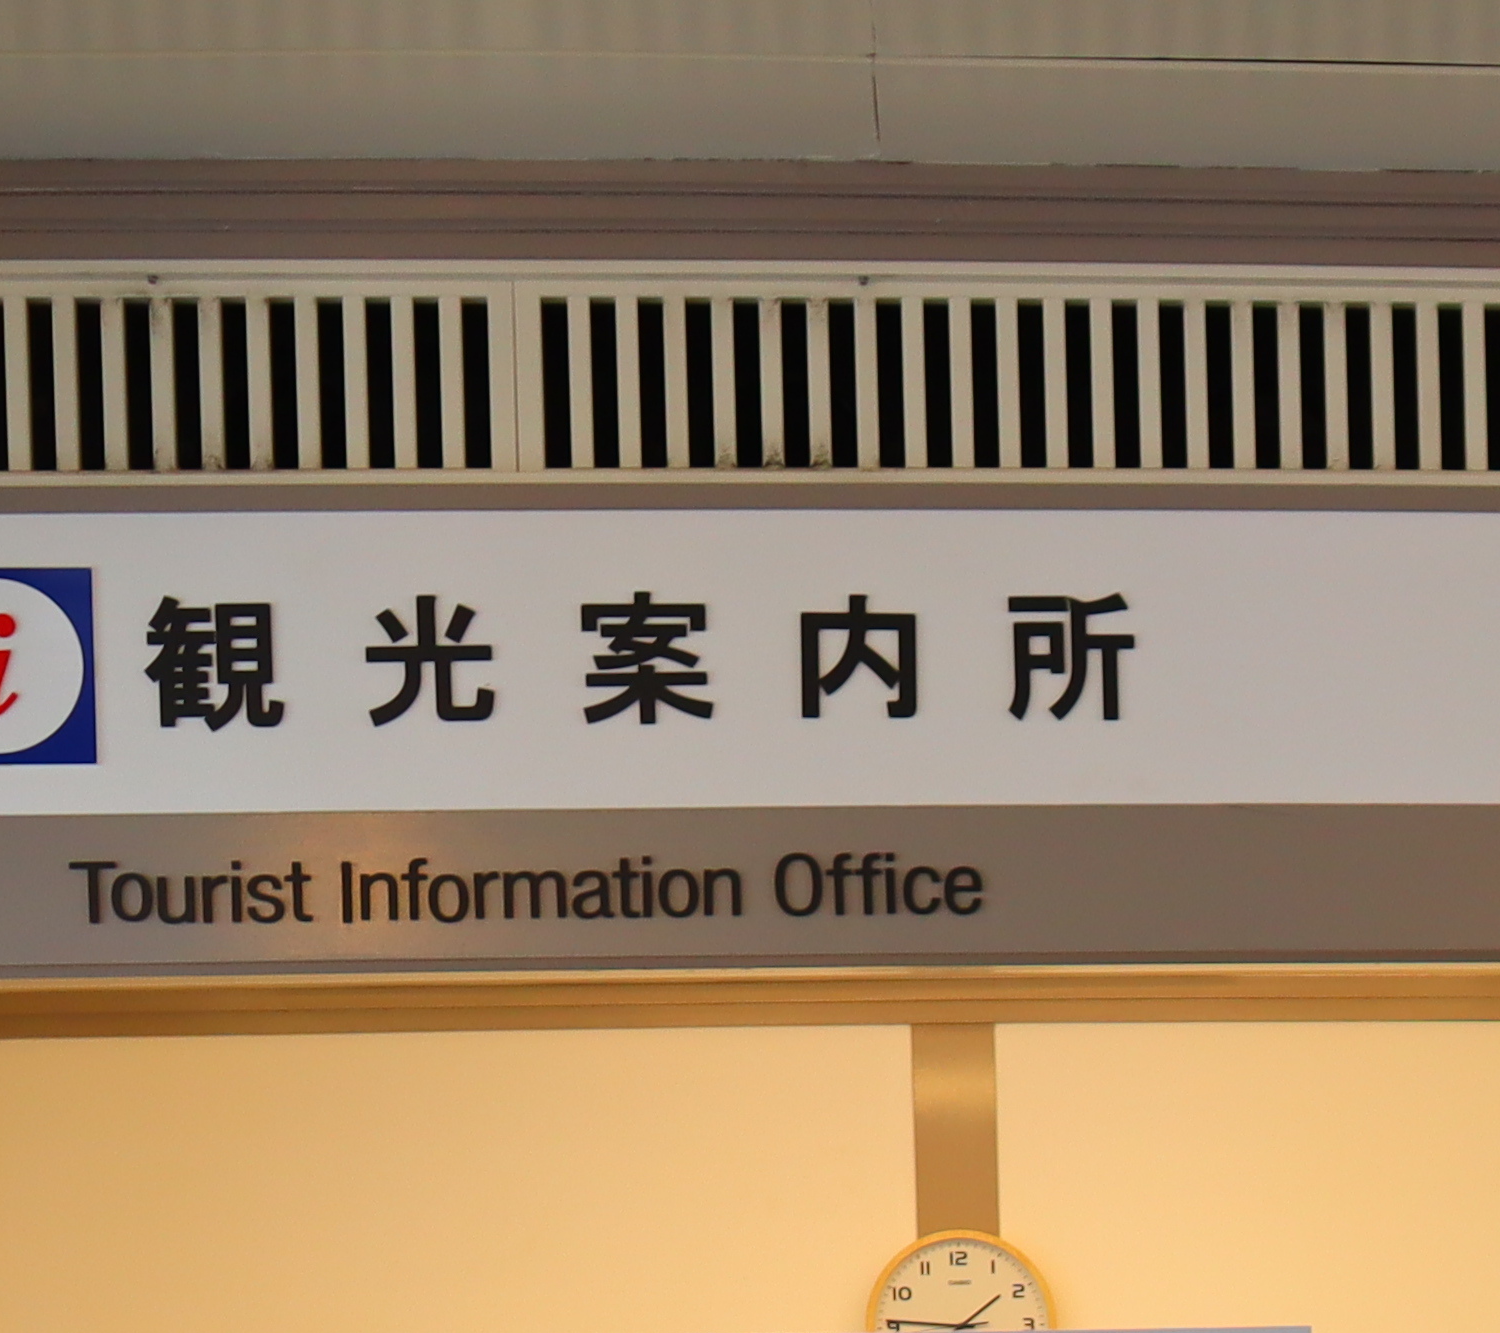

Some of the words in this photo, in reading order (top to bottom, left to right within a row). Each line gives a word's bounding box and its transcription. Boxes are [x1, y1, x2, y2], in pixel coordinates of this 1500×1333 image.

[145, 591, 1137, 732] 観光案内所
[69, 857, 313, 926] Tourist
[340, 852, 743, 925] Information
[774, 851, 986, 918] Office
[949, 1251, 968, 1266] 12
[920, 1261, 930, 1275] 11
[892, 1286, 912, 1301] 10
[1012, 1284, 1025, 1298] 2
